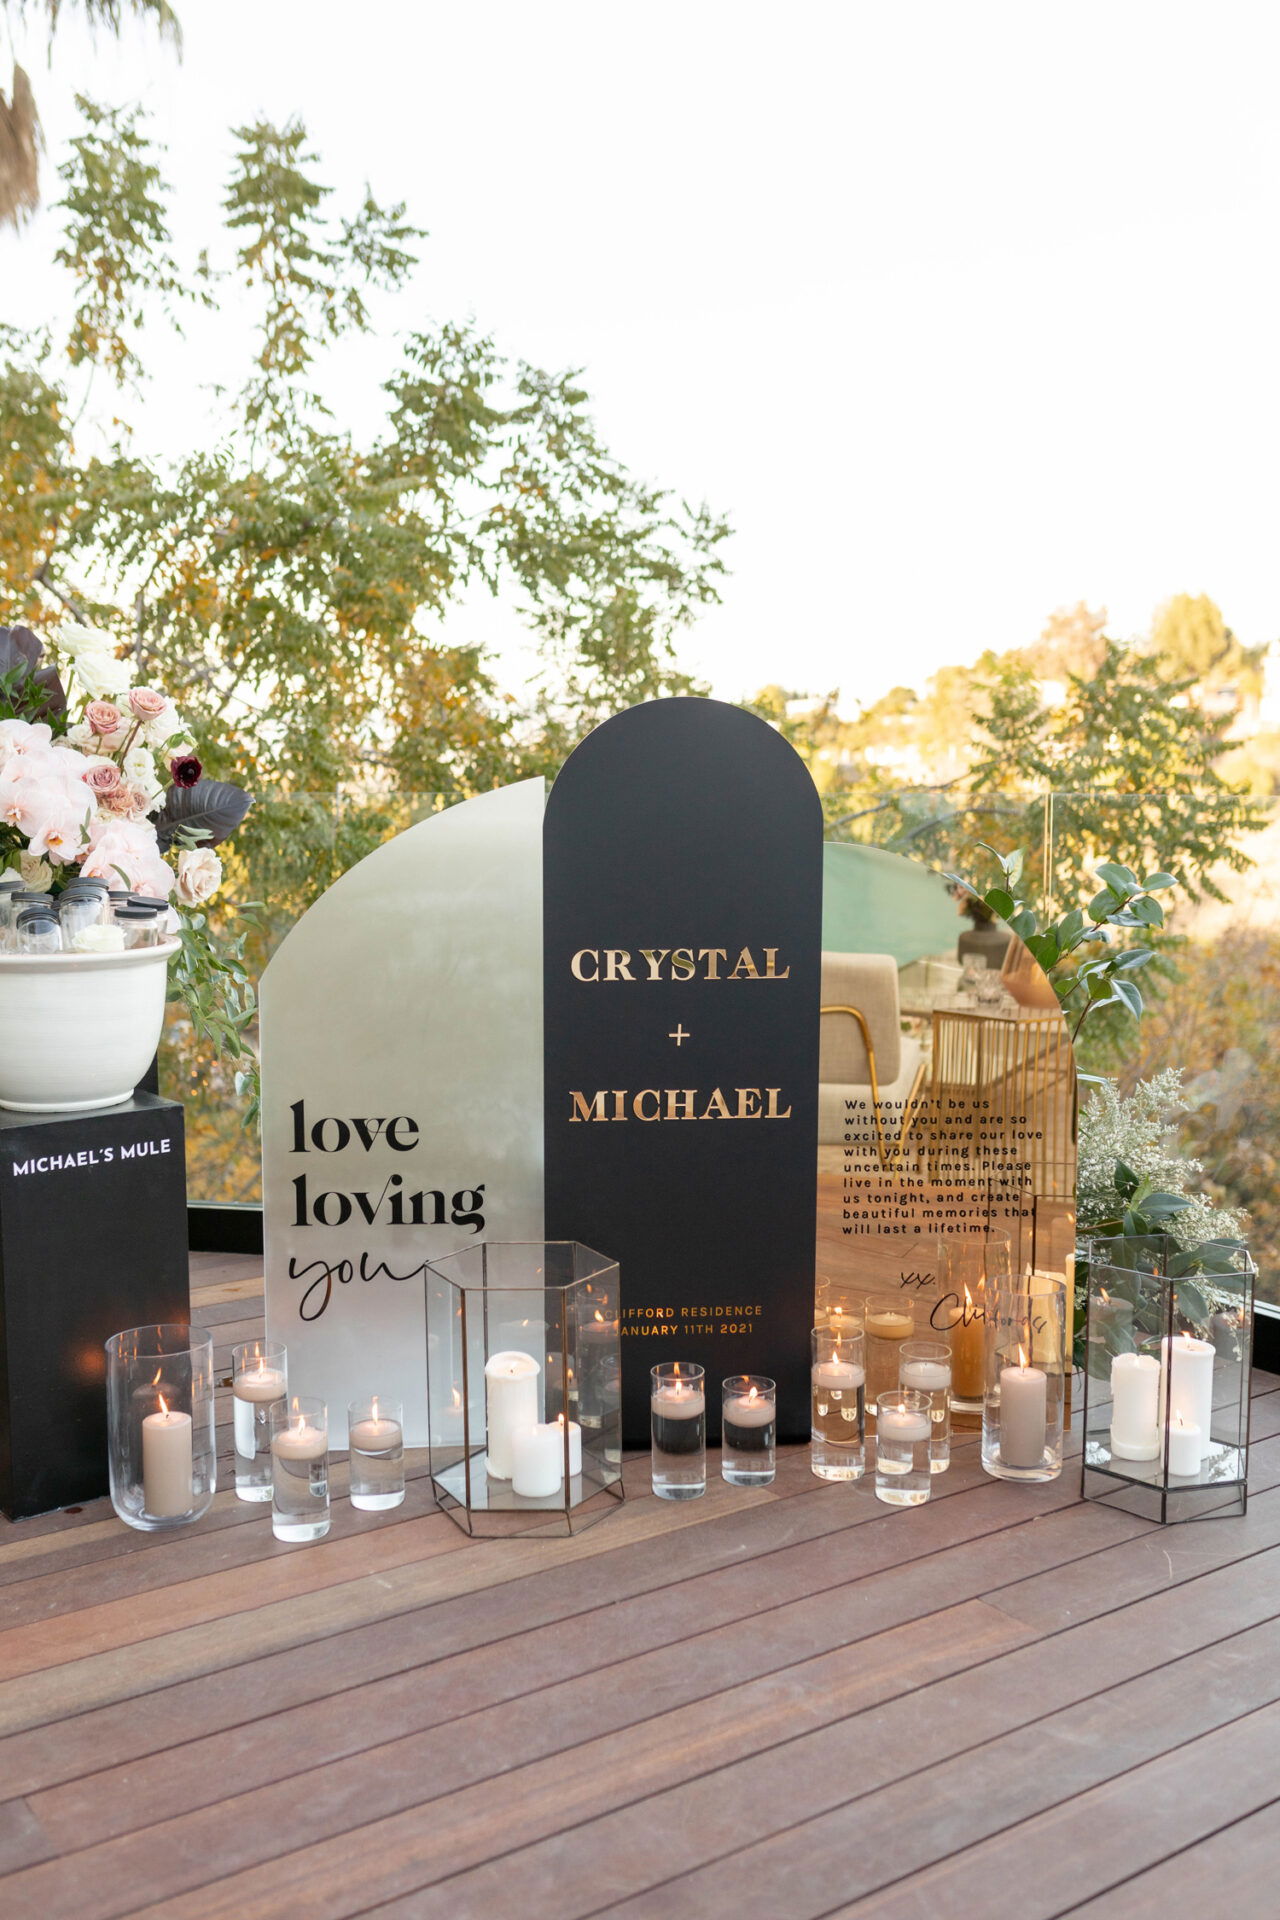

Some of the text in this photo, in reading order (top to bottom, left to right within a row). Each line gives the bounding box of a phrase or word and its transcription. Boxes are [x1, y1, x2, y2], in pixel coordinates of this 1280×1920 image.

[570, 946, 790, 982] CRYSTAL
[569, 1087, 792, 1122] MICHAEL
[845, 1098, 990, 1109] We wouldn't be us
[288, 1099, 420, 1153] love
[845, 1114, 1027, 1128] without you and are so
[844, 1129, 1043, 1141] excited to share our love
[13, 1138, 171, 1177] MICHAEL'S MULE
[844, 1145, 1018, 1159] with you during these
[844, 1160, 1031, 1172] uncertain times. Please
[843, 1176, 1032, 1188] live in the moment with
[290, 1173, 486, 1235] loving
[843, 1192, 1020, 1205] us tonight, and create
[843, 1206, 1036, 1219] beautiful memories that
[842, 1222, 995, 1234] will last a lifetime.
[288, 1251, 429, 1321] you
[681, 1305, 763, 1317] RESIDENCE
[684, 1323, 714, 1334] 11TH
[720, 1323, 753, 1334] 2021
